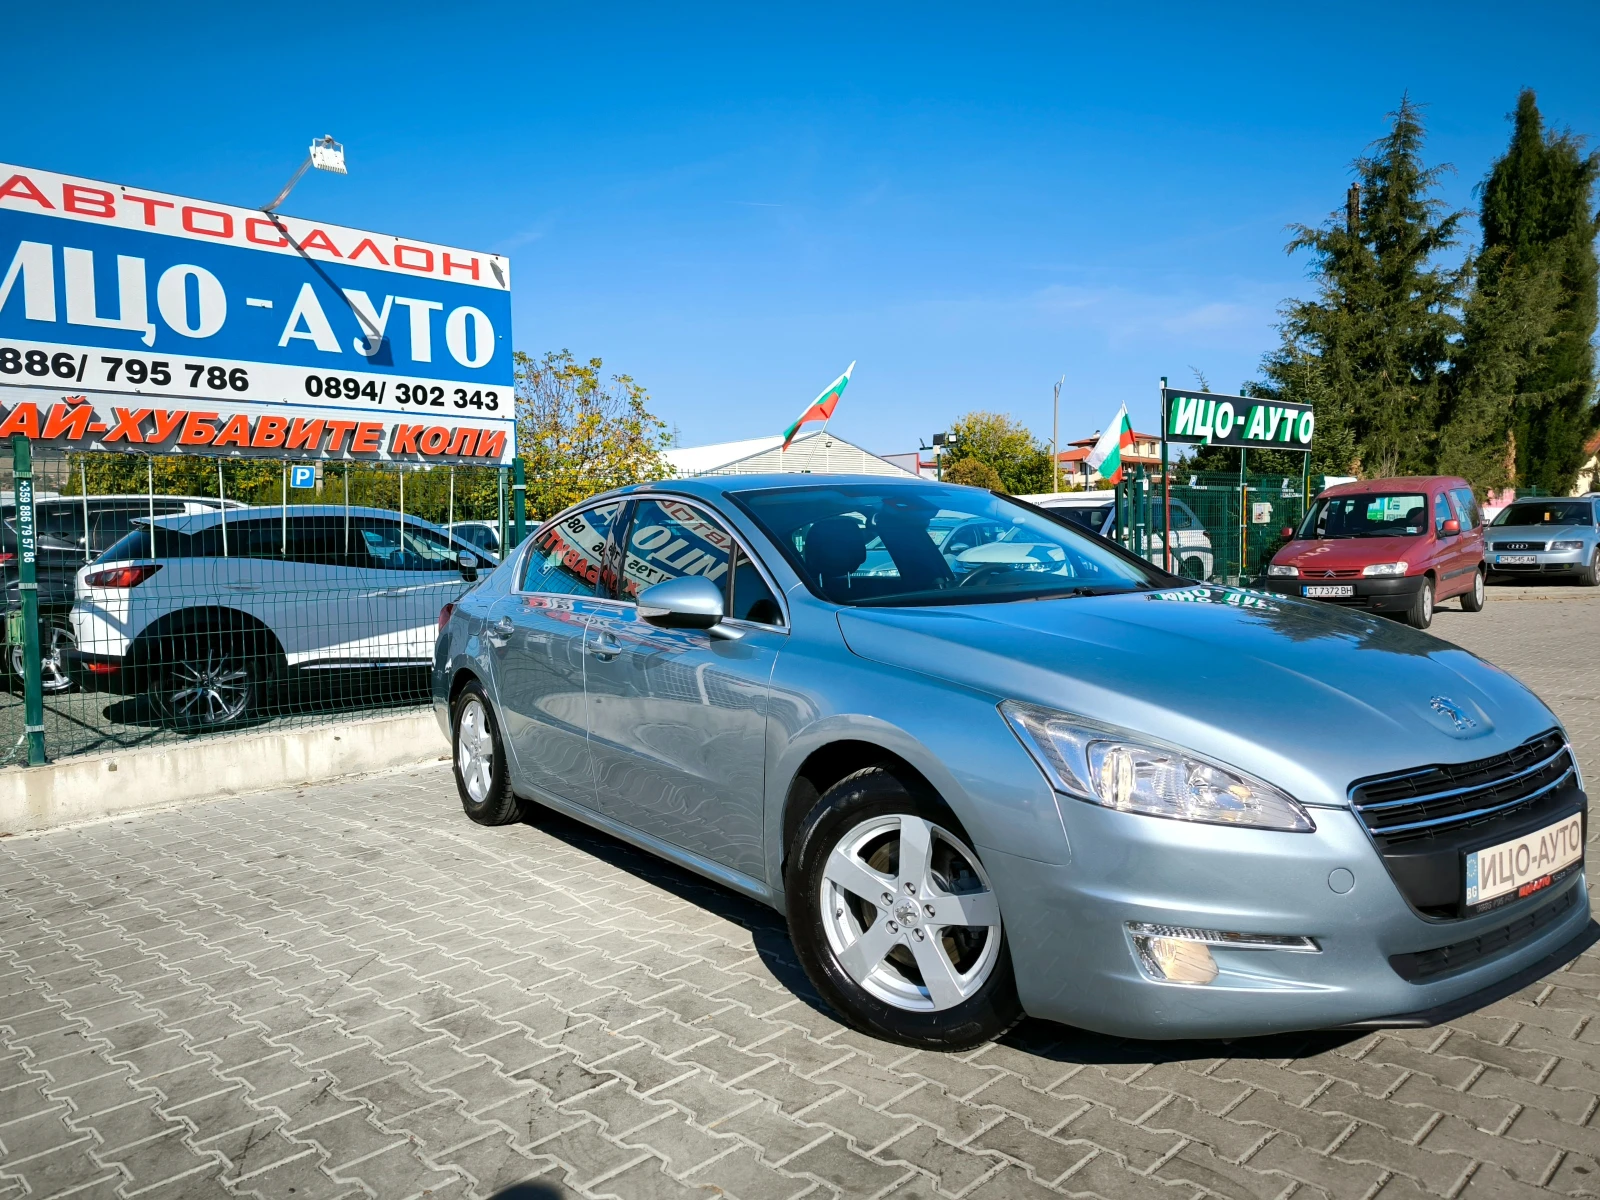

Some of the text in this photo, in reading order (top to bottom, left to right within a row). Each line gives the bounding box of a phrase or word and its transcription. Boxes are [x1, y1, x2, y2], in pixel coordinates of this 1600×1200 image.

[0, 174, 481, 281] АВТОСАЛОН
[101, 356, 171, 385] 795
[185, 363, 249, 391] 786
[305, 375, 386, 404] 0894/
[395, 383, 445, 407] 302
[453, 388, 499, 411] 343
[391, 423, 507, 458] КОЛИ
[1173, 397, 1315, 446] ИЦО-АУТО
[295, 468, 310, 485] P
[20, 480, 35, 563] +359 886 79 57 86
[1320, 587, 1340, 595] 7372
[1481, 820, 1580, 892] ИЦО-АУТО
[1466, 885, 1478, 899] BG
